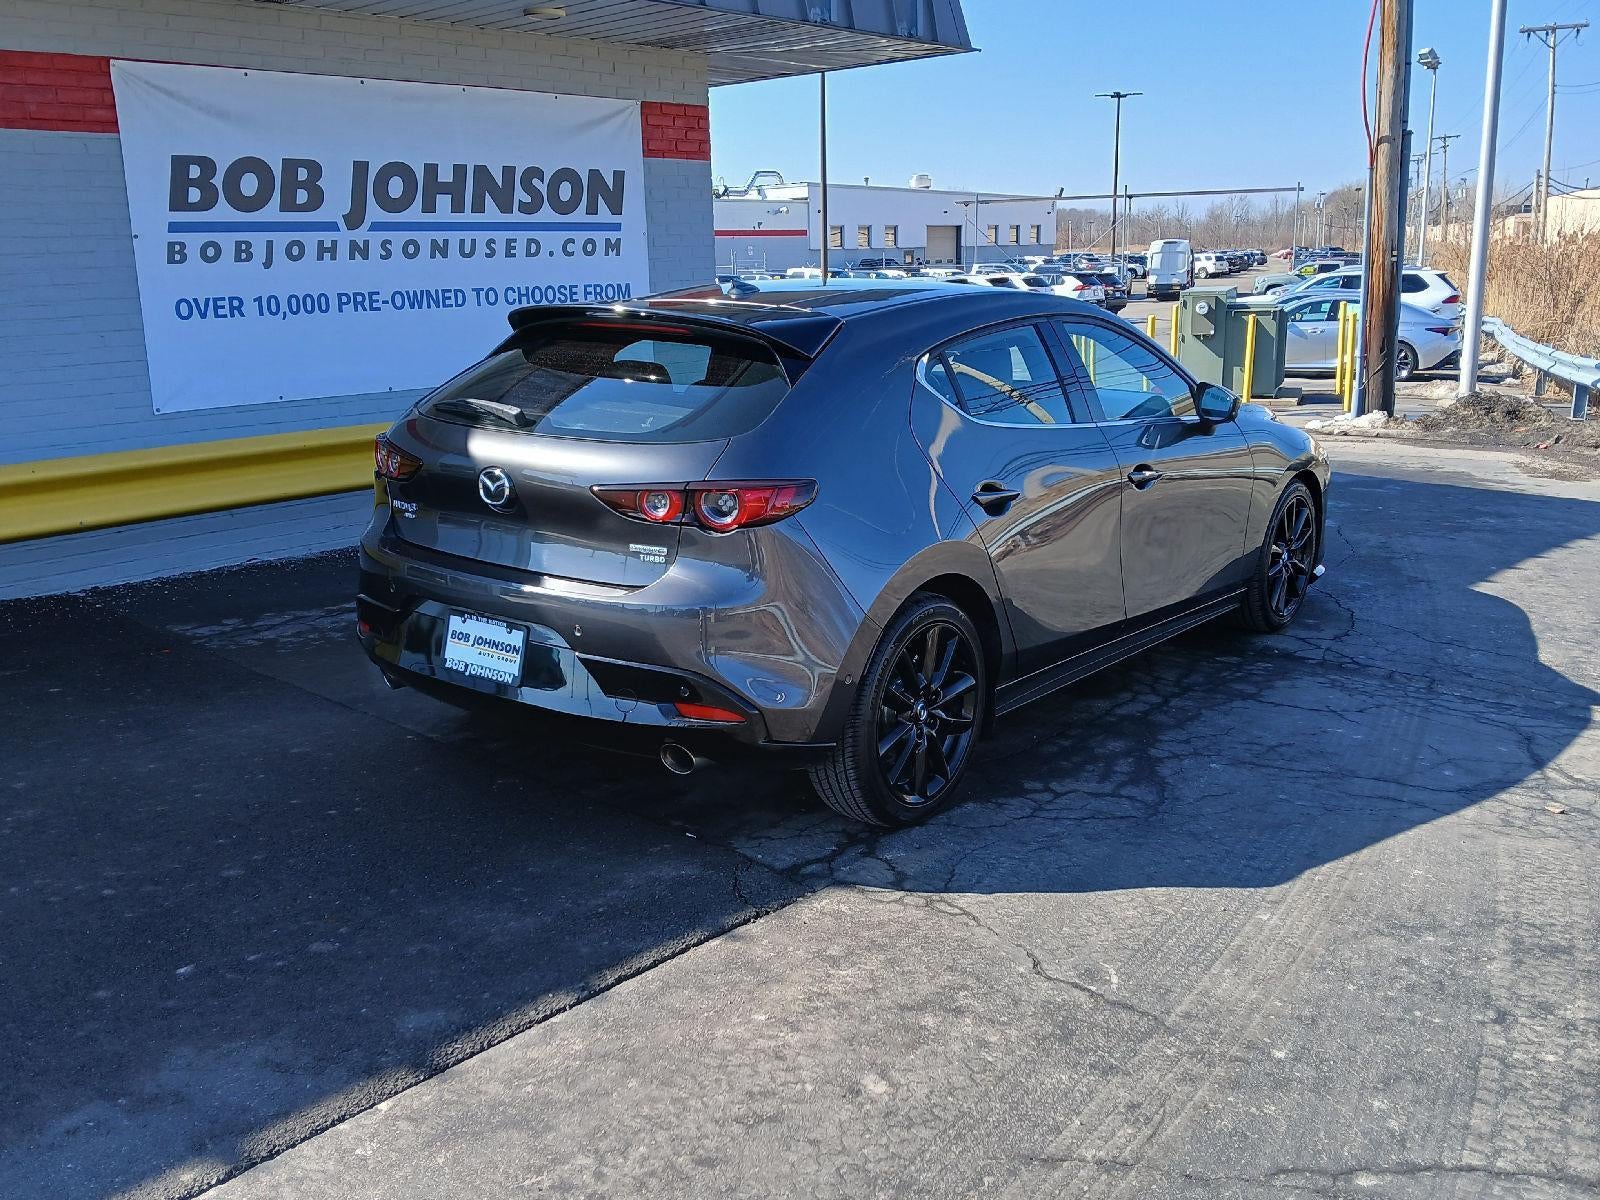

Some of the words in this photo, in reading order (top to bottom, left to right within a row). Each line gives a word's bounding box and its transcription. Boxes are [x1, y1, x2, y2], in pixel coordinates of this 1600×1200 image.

[168, 154, 325, 213] BOB
[341, 160, 626, 231] JOHNSON
[166, 237, 622, 270] BOBJOHNSONUSED.COM
[174, 296, 246, 321] OVER
[253, 292, 331, 321] 10,000
[336, 287, 467, 314] PRE-OWNED
[472, 286, 499, 307] TO
[503, 284, 579, 305] CHOOSE
[583, 282, 631, 302] FROM
[640, 554, 666, 563] TURBO
[450, 629, 471, 643] BOB
[471, 634, 522, 656] JOHNSON
[445, 658, 466, 672] BOB
[465, 662, 514, 684] JOHNSON
